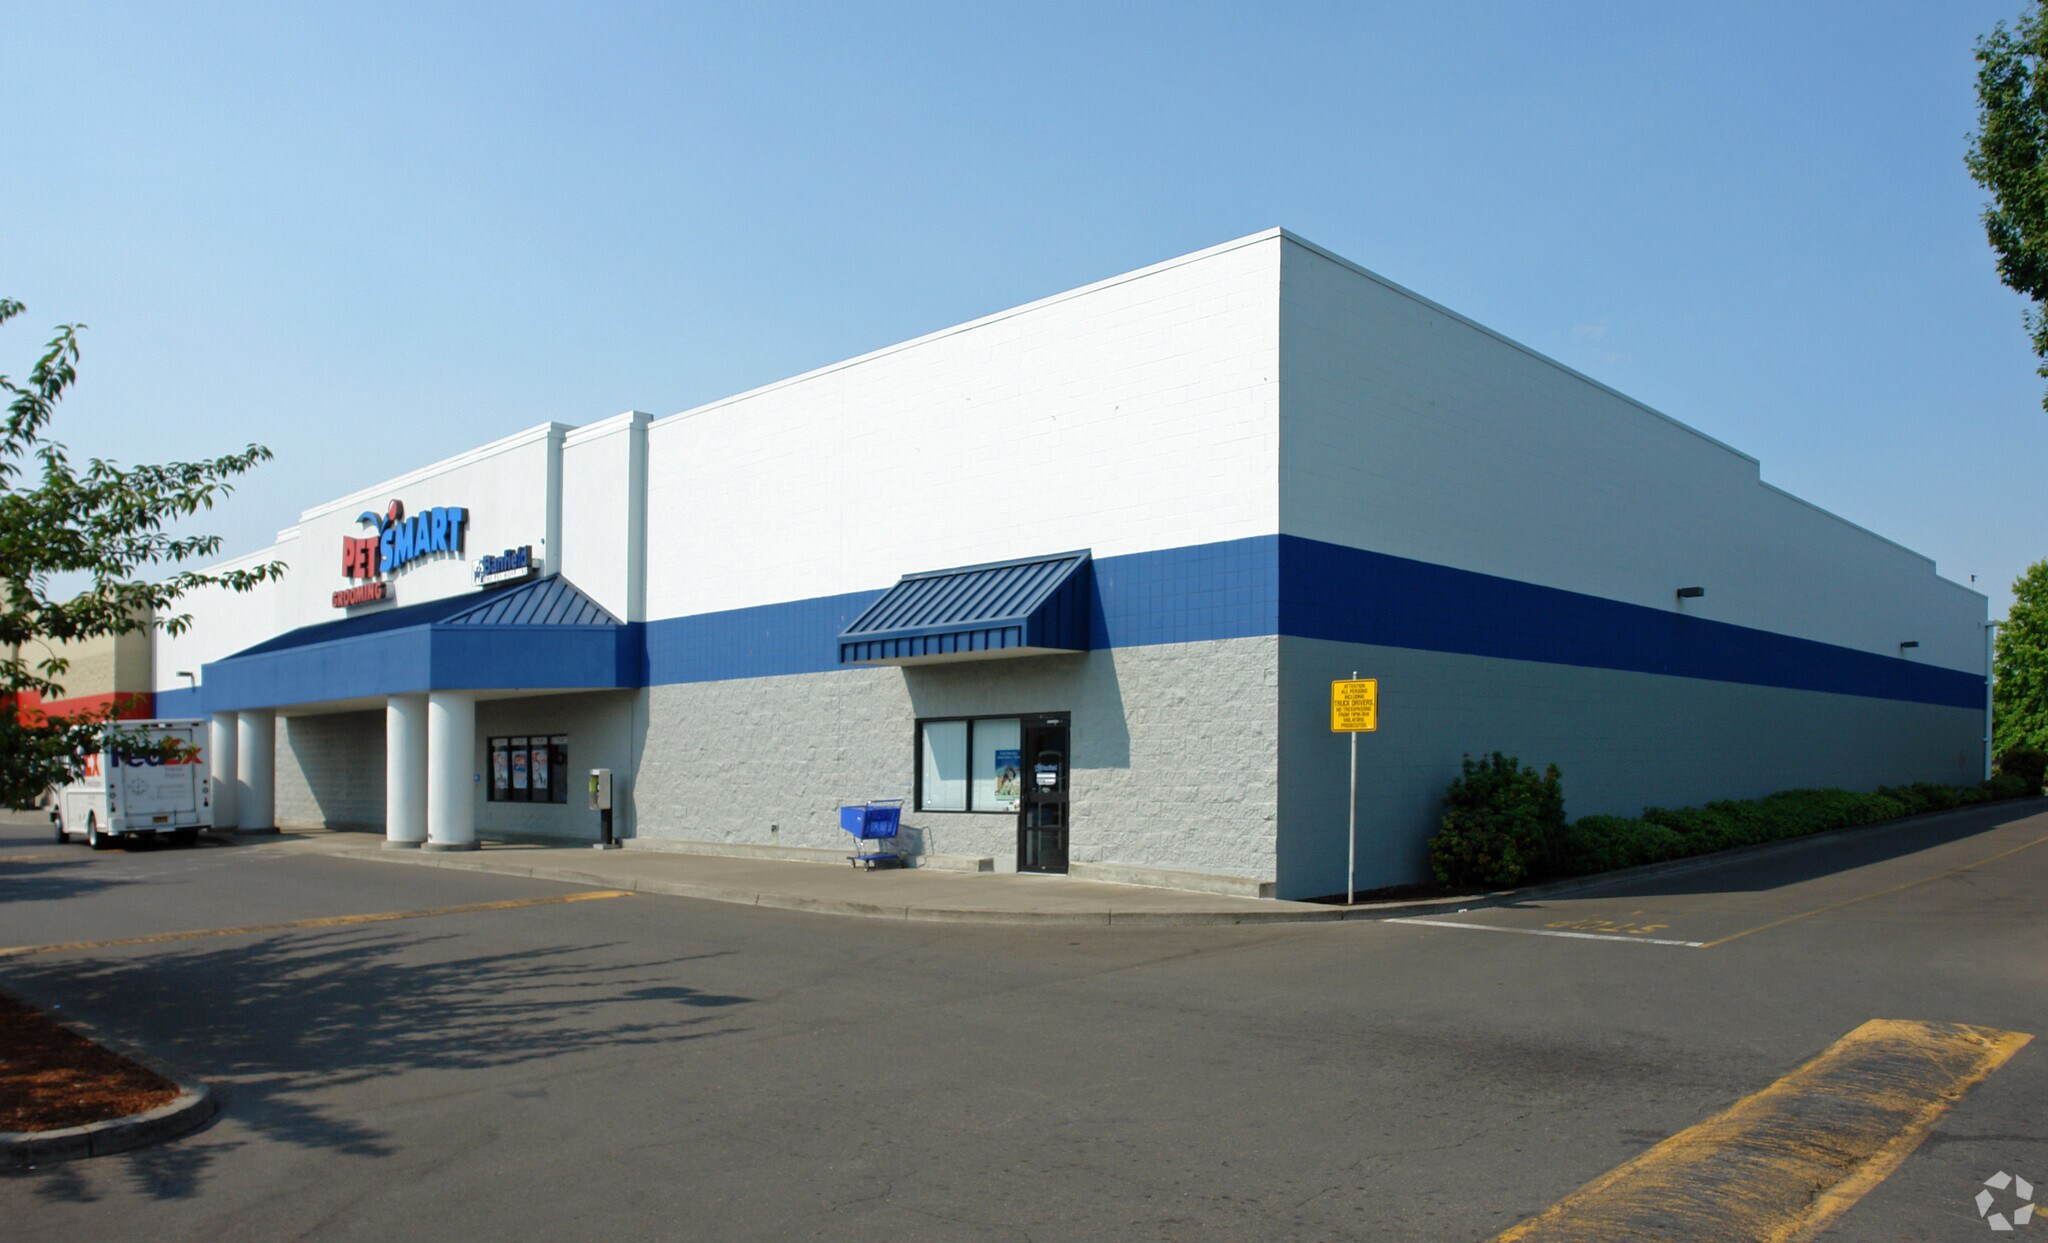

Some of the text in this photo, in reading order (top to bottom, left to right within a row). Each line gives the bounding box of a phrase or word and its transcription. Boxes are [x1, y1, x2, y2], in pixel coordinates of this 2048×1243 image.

[342, 506, 463, 578] PETSMART
[483, 546, 528, 574] Banfield
[332, 582, 382, 608] GROOMING
